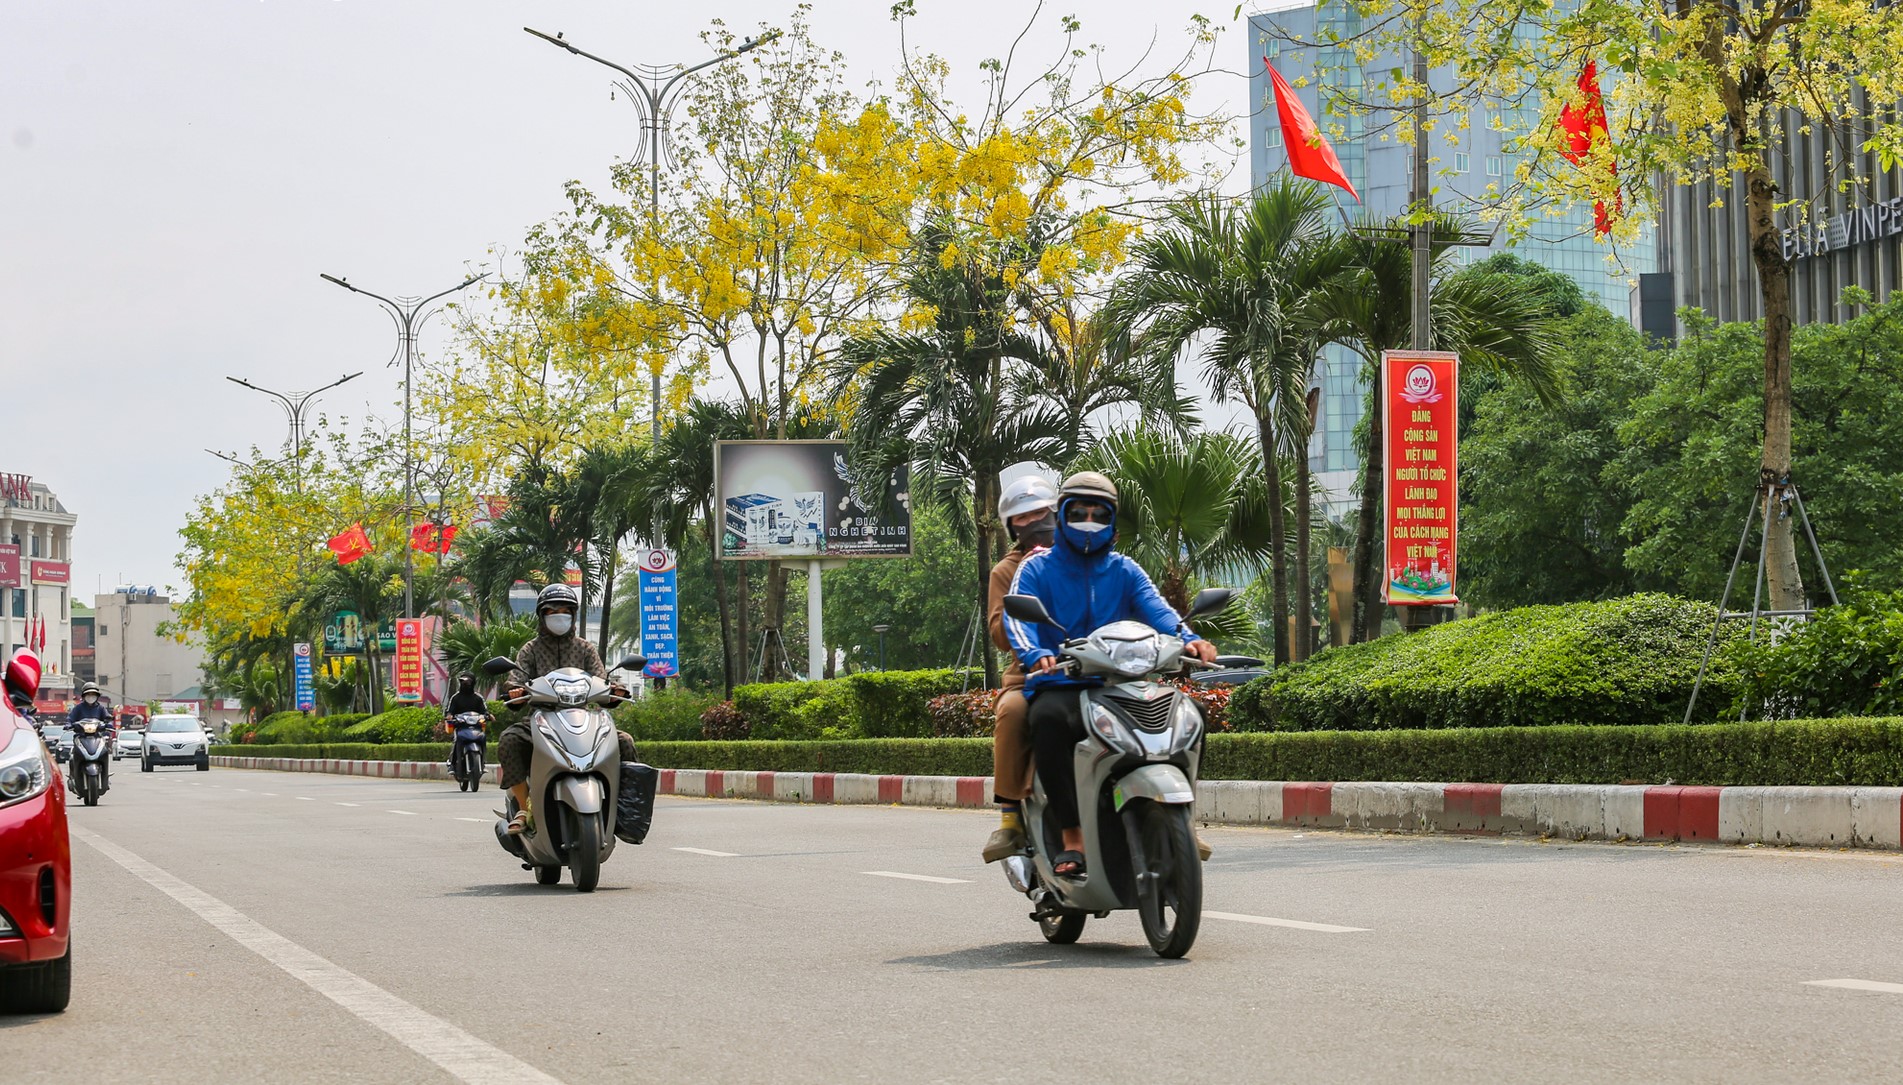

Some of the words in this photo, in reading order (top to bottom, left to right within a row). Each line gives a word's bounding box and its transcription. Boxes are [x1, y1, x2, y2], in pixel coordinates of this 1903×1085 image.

[1412, 406, 1431, 422] ĐẢNG
[1404, 427, 1424, 444] CỘNG
[1426, 425, 1438, 442] SẢN
[1406, 447, 1420, 463] VIỆT
[1423, 449, 1437, 461] NAM
[1396, 466, 1418, 480] NGƯỜI
[1420, 464, 1428, 480] TỔ
[1430, 466, 1446, 480] CHỨC
[1405, 486, 1424, 500] LÃNH
[1426, 488, 1437, 502] ĐẠO
[1397, 507, 1410, 521] MỌI
[1413, 503, 1434, 519] THẮNG
[1435, 507, 1445, 522] LỢI
[1394, 522, 1408, 538] CỦA
[1410, 524, 1429, 538] CÁCH
[1431, 527, 1448, 541] MẠNG
[1407, 544, 1422, 558] VIỆT
[660, 614, 670, 622] VIỆC
